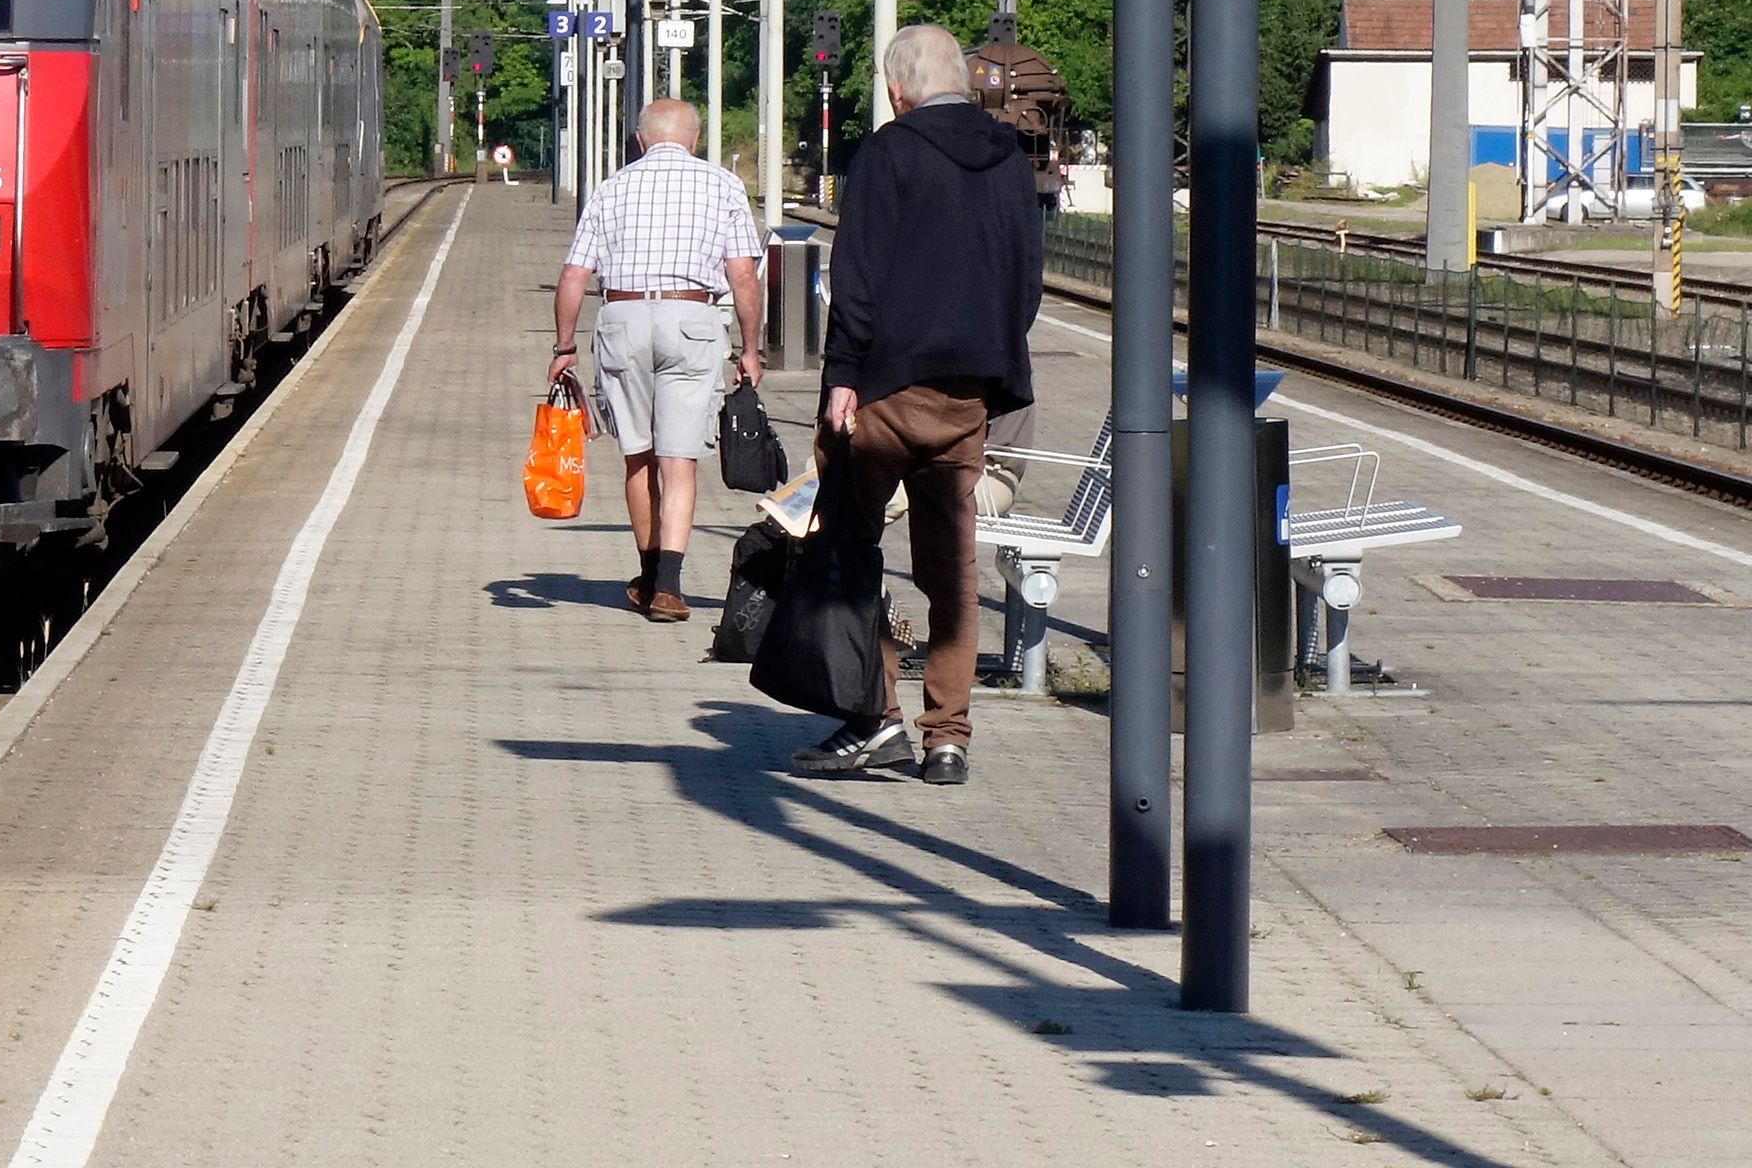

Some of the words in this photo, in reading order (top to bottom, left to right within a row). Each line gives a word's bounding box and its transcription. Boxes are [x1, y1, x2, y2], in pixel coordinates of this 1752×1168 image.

[556, 15, 569, 33] 3
[594, 16, 607, 34] 2
[666, 29, 687, 39] 140
